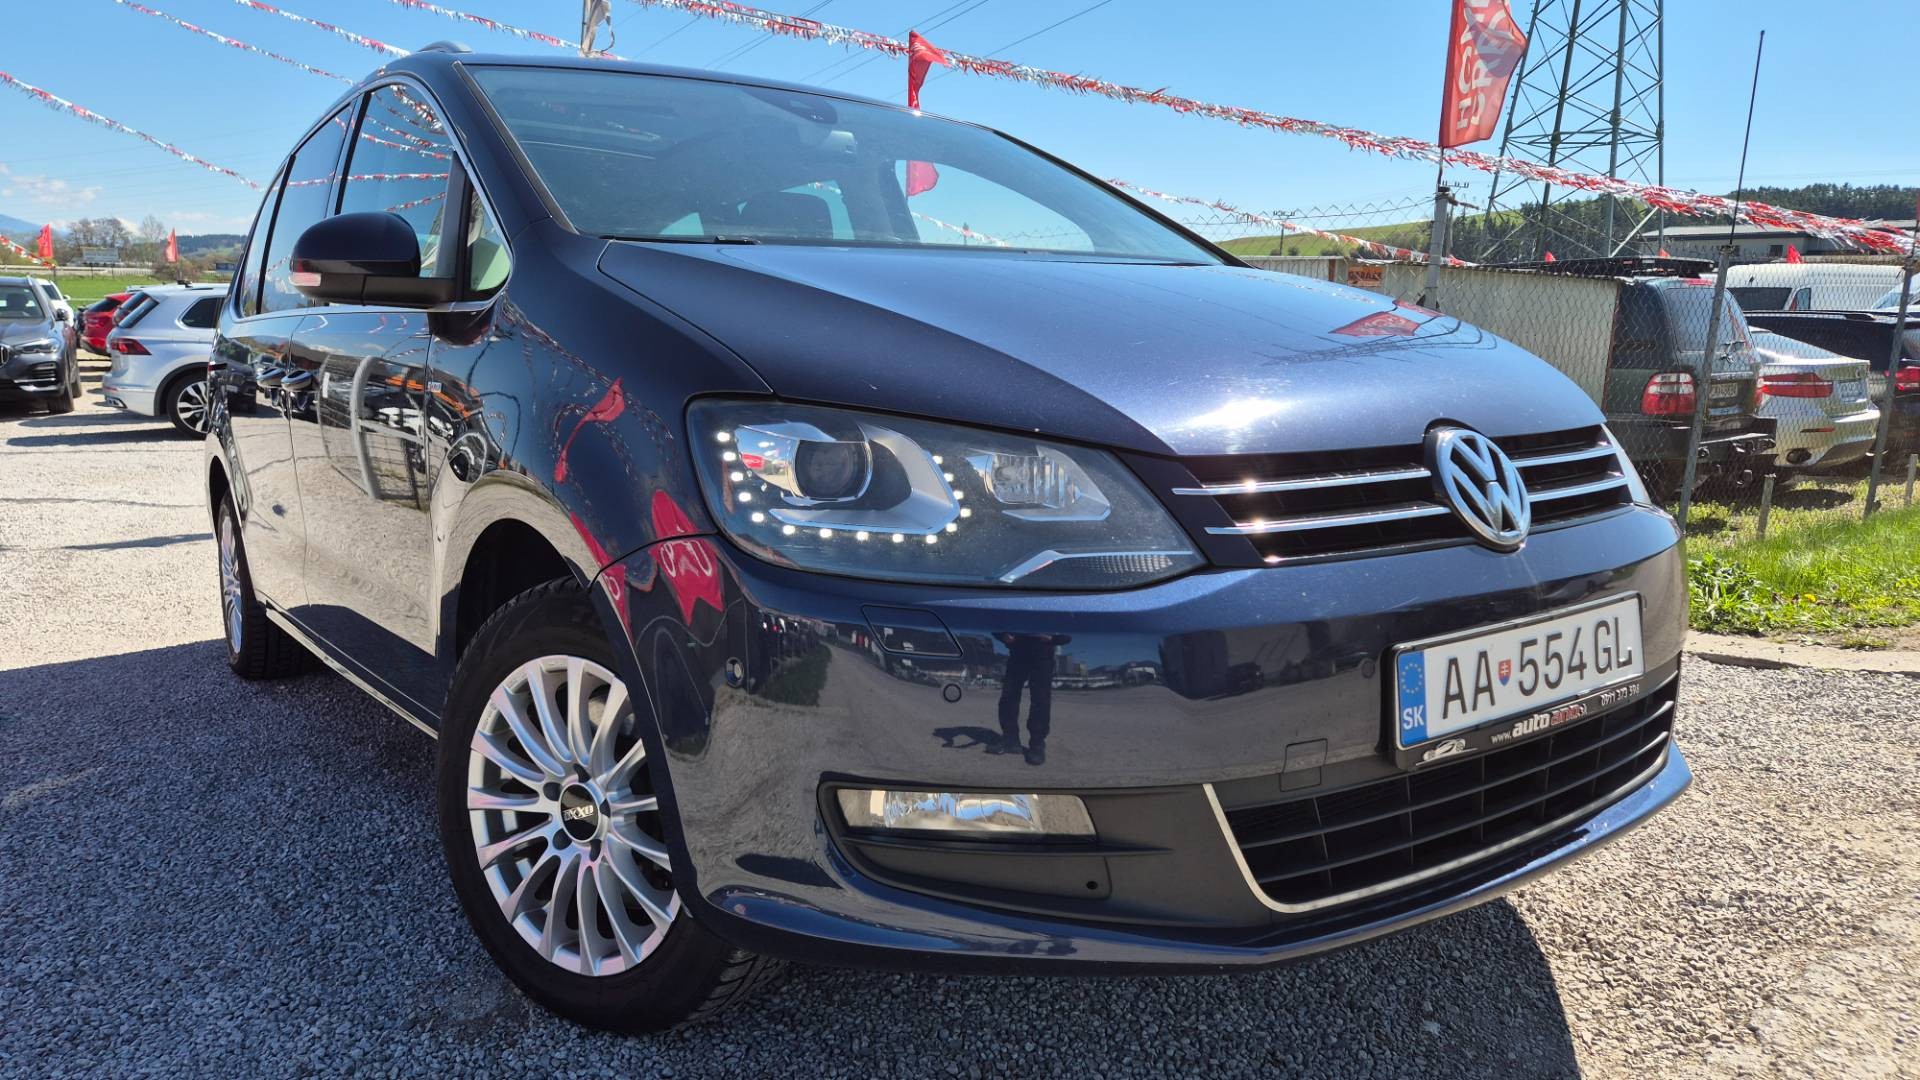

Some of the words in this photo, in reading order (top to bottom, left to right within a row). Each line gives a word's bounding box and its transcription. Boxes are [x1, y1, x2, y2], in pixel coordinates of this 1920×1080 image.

[1442, 650, 1497, 720] AA
[1518, 616, 1634, 697] 554GL
[1402, 704, 1425, 731] SK
